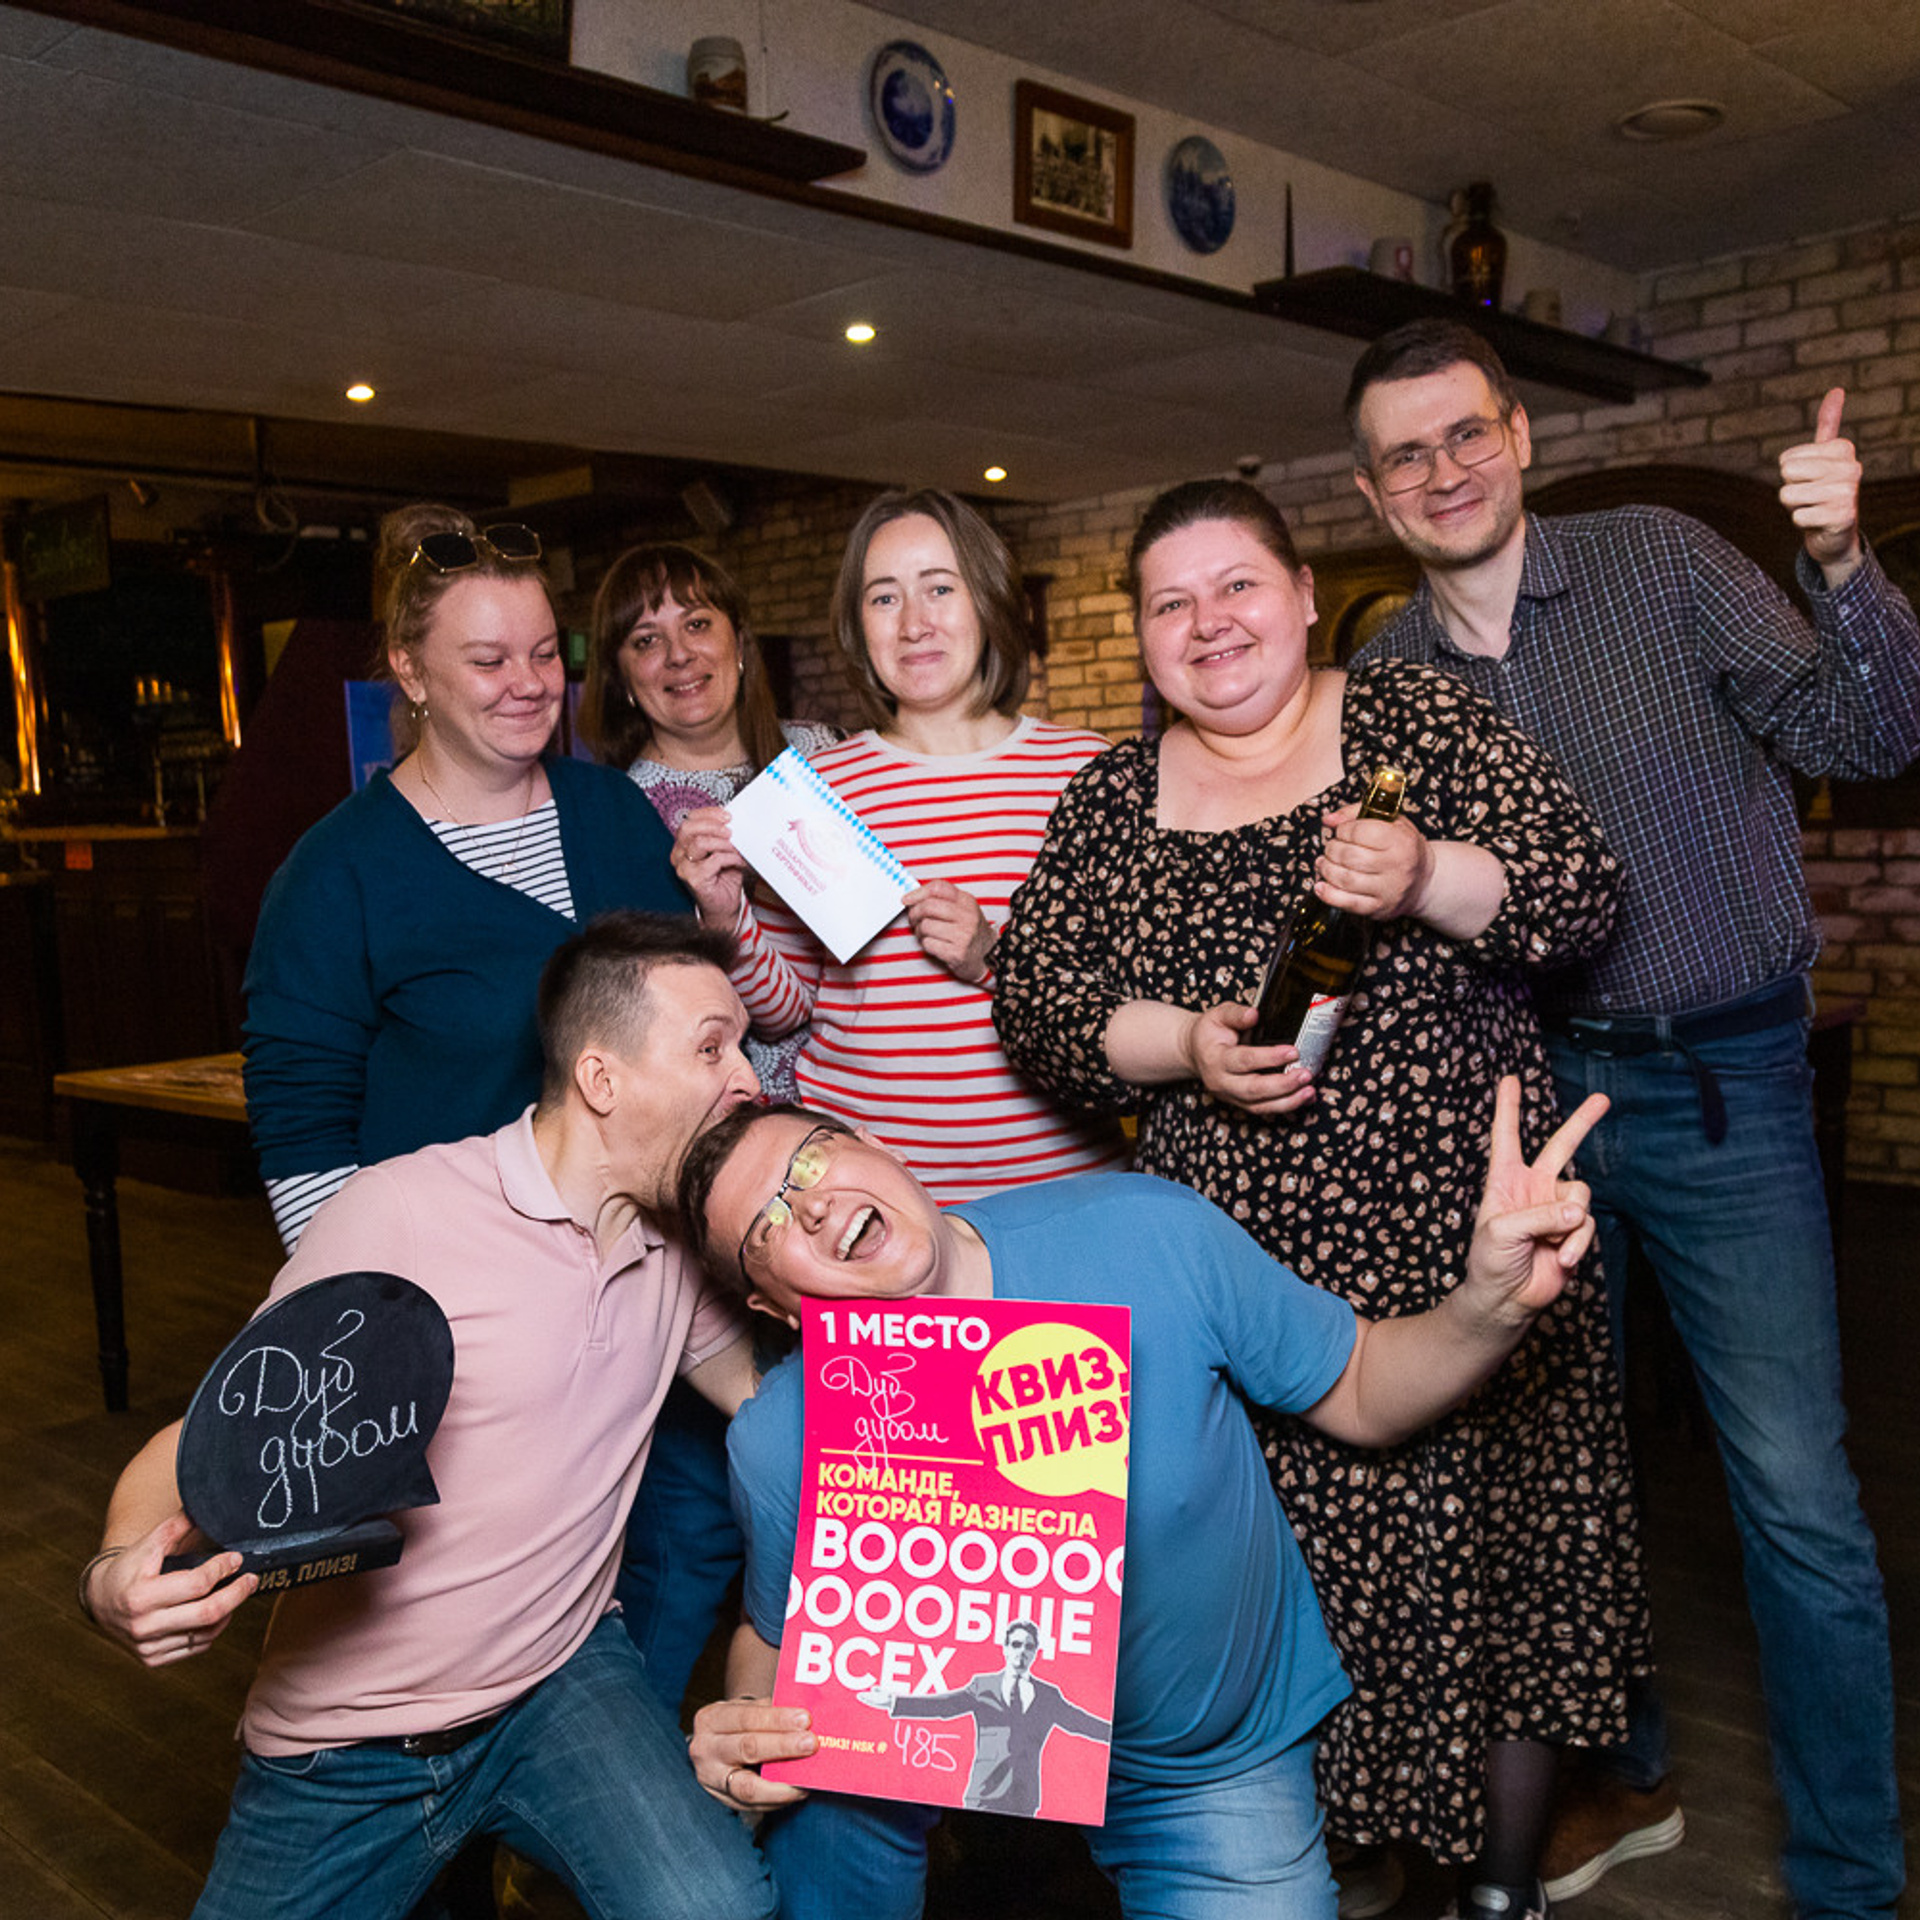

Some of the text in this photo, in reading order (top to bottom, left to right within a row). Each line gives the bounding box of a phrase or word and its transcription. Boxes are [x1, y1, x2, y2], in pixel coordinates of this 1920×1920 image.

[772, 847, 818, 896] СЕРТИФИКАТ
[819, 1311, 991, 1352] 1 МЕСТО
[817, 1462, 961, 1501] КОМАНДЕ,
[815, 1490, 1098, 1539] КОТОРАЯ РАЗНЕСЛА
[259, 1552, 359, 1591] ИЗ, ПЛИЗ!
[794, 1631, 956, 1696] ВСЕХ
[851, 1739, 876, 1754] NSK
[894, 1720, 962, 1772] 485
